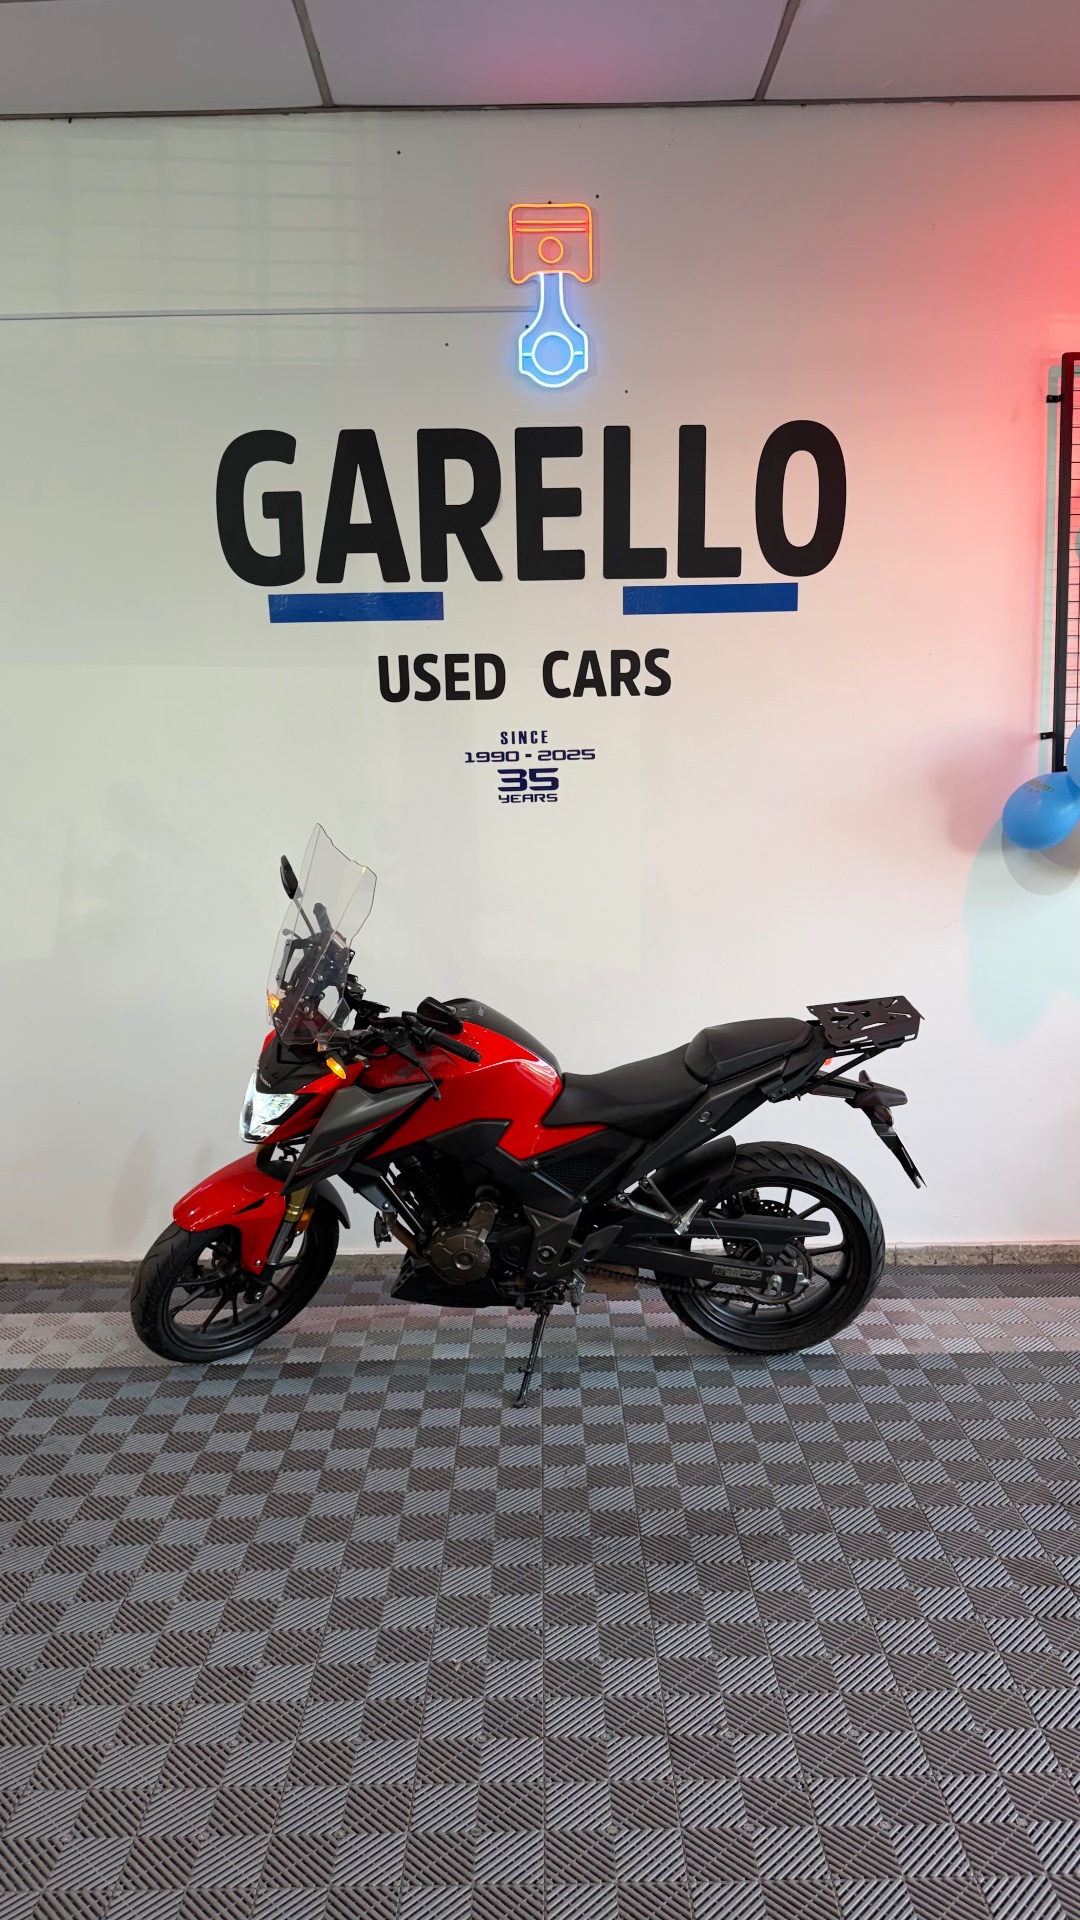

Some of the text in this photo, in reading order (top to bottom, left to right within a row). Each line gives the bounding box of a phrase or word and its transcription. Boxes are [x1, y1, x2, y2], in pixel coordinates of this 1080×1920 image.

[215, 419, 847, 587] GARELLO
[377, 647, 672, 703] USED CARS
[500, 730, 548, 745] SINCE
[464, 750, 520, 764] 1990
[537, 748, 596, 762] 2025
[497, 767, 559, 792] 35
[498, 793, 558, 804] YEARS
